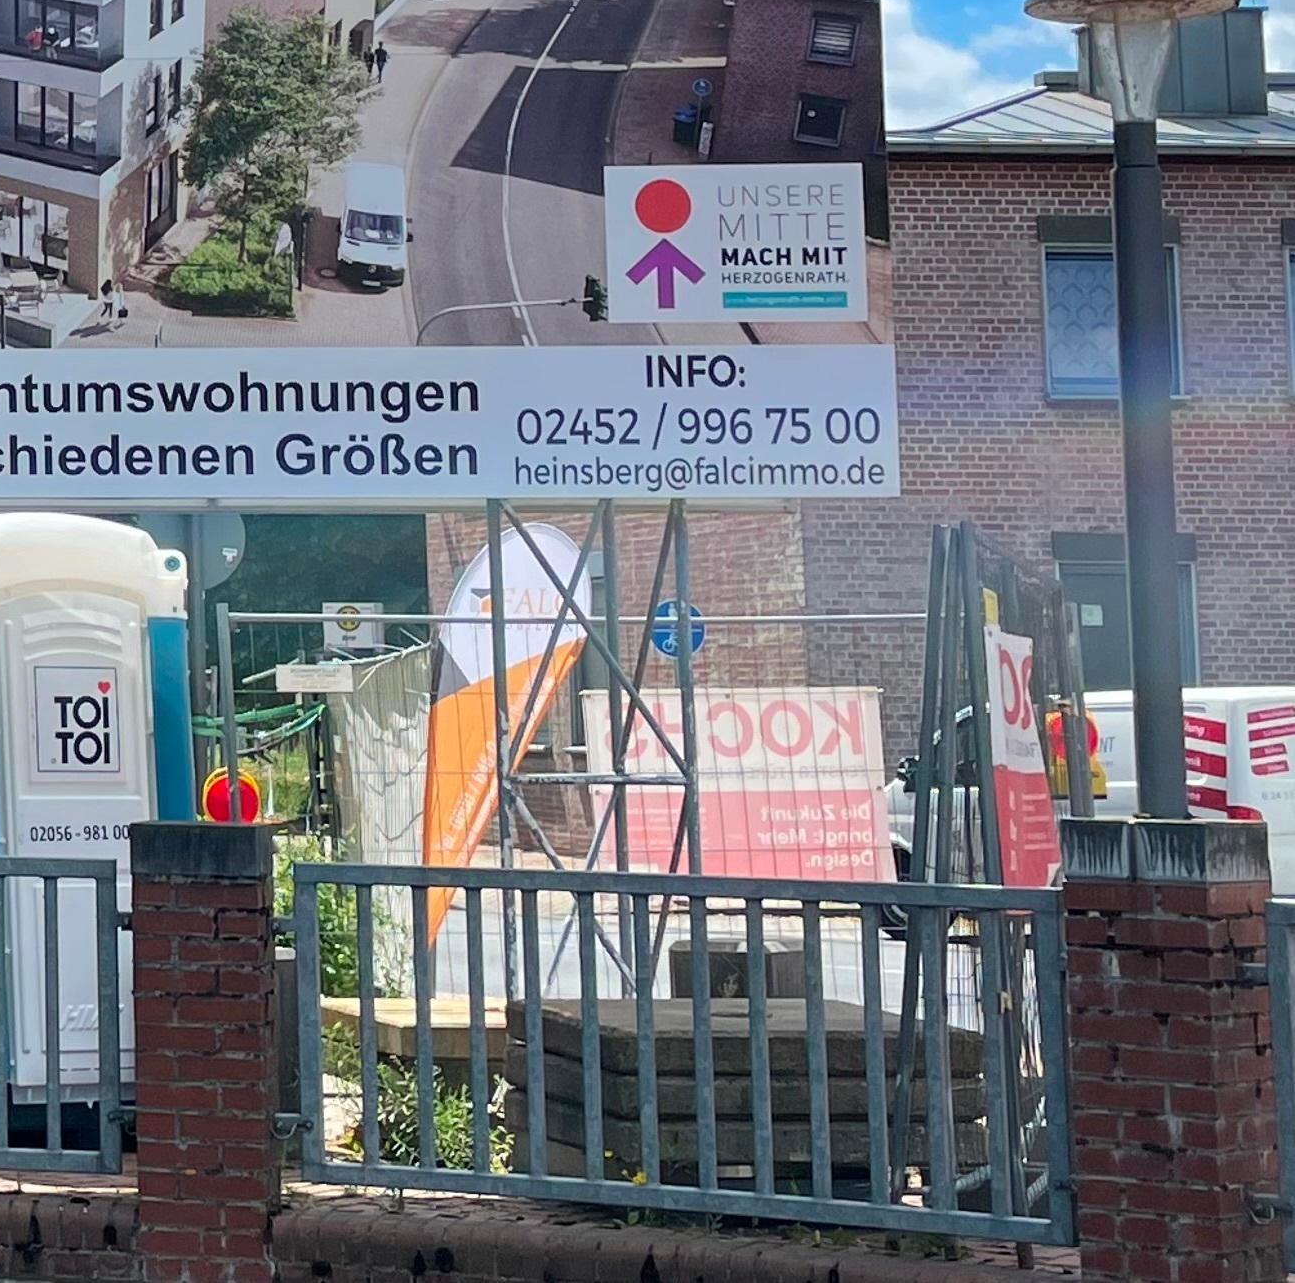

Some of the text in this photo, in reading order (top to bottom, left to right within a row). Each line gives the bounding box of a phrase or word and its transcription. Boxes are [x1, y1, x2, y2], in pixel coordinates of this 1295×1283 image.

[718, 184, 845, 207] UNSERE
[719, 212, 845, 241] MITTE
[721, 246, 848, 266] MACH MIT
[645, 354, 746, 388] INFO:
[517, 402, 880, 451] 02452 / 996 75 00
[275, 431, 479, 476] Größen
[514, 456, 886, 492] heinsberg@falcimmo.de
[54, 696, 110, 729] TOI
[55, 731, 111, 765] TOI
[30, 825, 73, 842] 02056
[83, 824, 109, 841] 981
[113, 824, 130, 840] 00
